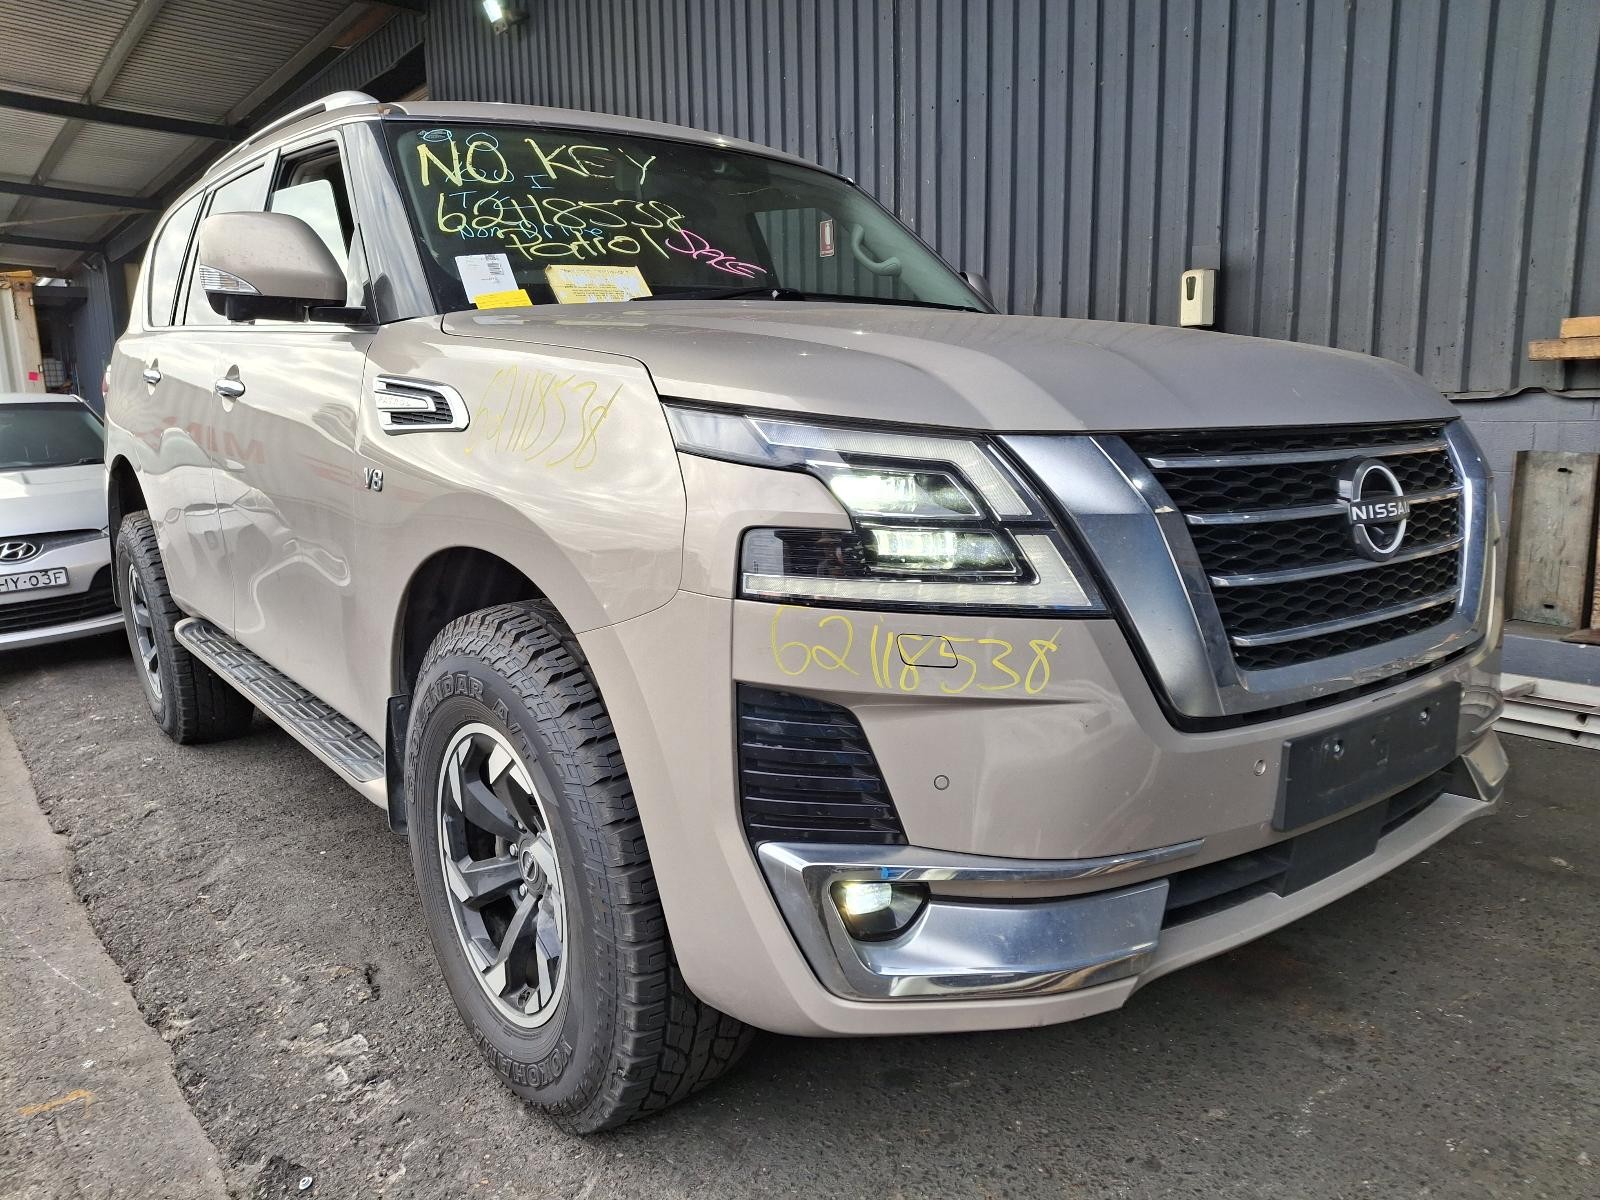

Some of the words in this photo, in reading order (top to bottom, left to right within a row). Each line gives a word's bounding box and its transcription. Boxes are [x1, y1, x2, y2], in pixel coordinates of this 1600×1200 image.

[416, 139, 509, 187] NO
[523, 137, 657, 186] KEY
[363, 467, 384, 492] V8
[1351, 500, 1411, 521] NISSAN
[768, 604, 1065, 695] 62118538
